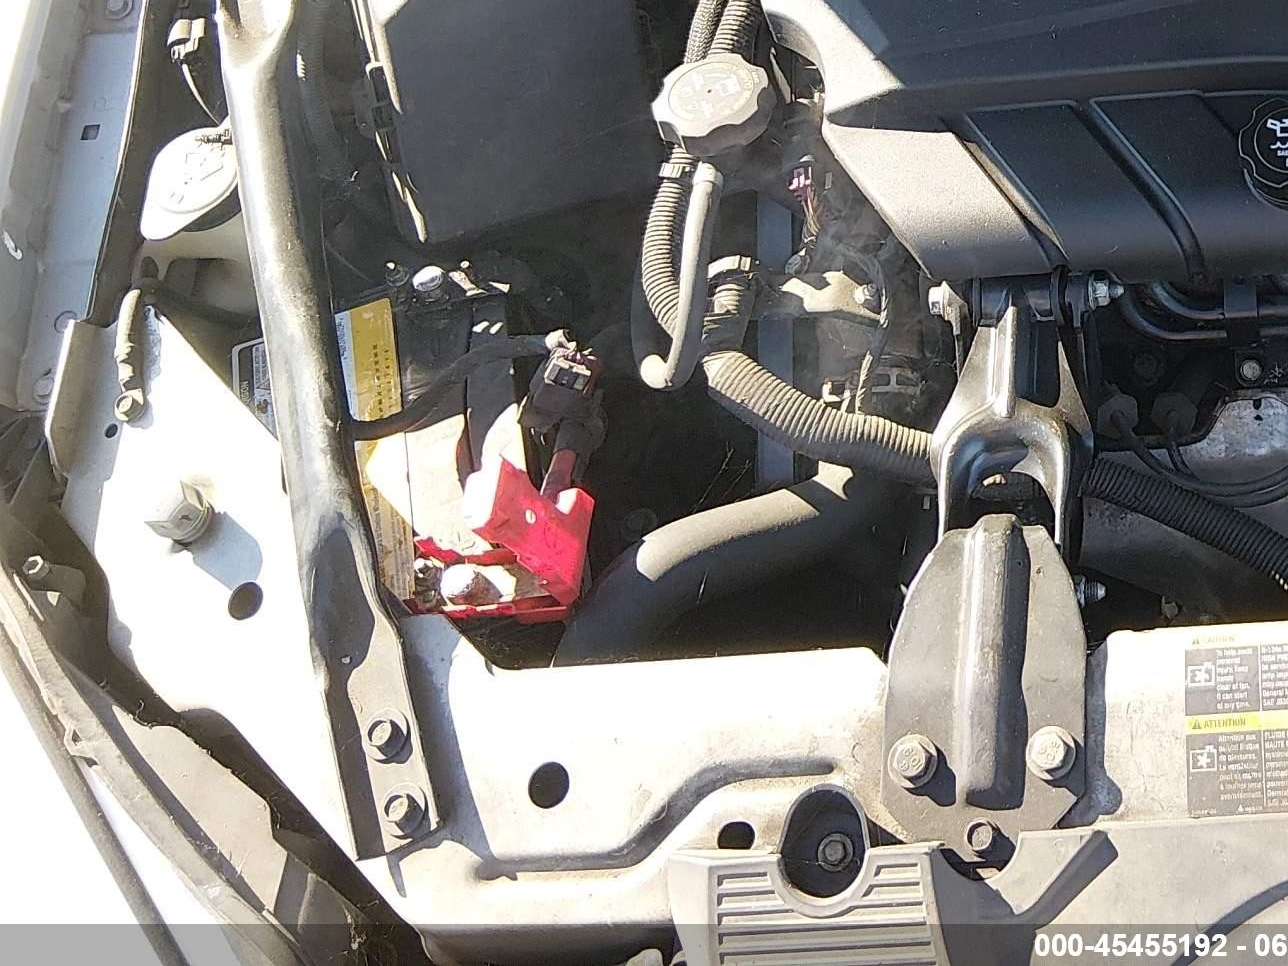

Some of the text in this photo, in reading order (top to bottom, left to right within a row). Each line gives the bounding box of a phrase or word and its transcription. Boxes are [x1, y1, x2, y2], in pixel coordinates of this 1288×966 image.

[1203, 634, 1235, 643] AUTION
[1216, 683, 1231, 691] clear
[1261, 680, 1275, 688] may
[1221, 692, 1233, 700] can
[1262, 688, 1284, 697] General
[1262, 697, 1275, 707] SAE
[1203, 719, 1246, 729] ATTENTION
[1264, 729, 1285, 739] FLUIDE
[1264, 739, 1285, 749] HAUTE
[1266, 787, 1288, 797] General
